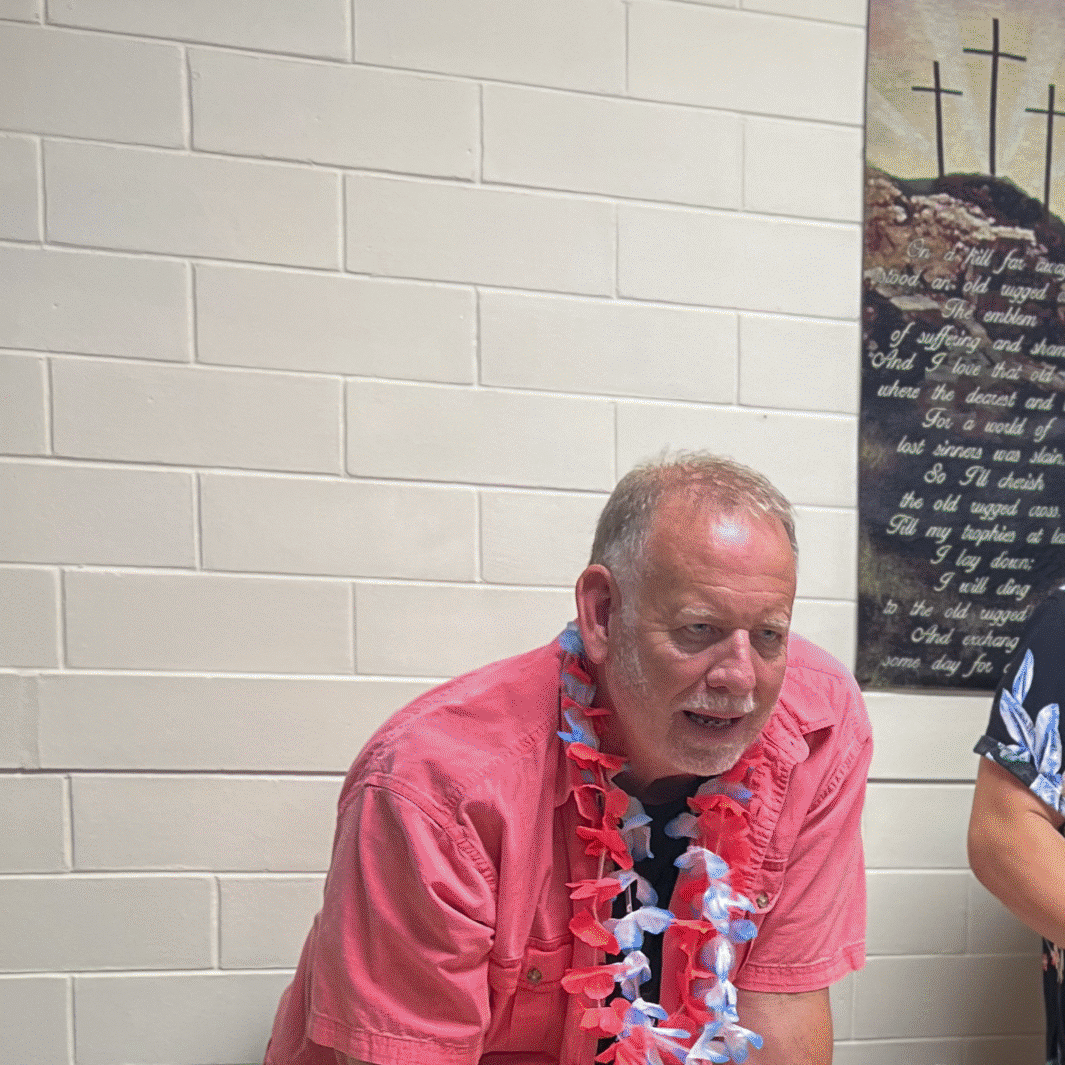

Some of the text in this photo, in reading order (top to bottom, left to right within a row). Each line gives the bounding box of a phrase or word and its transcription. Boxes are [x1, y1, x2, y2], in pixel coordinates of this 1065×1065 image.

[965, 248, 993, 267] hill
[993, 250, 1026, 274] far
[963, 277, 991, 294] old
[1000, 283, 1049, 304] rugged
[941, 298, 1038, 327] The emblem
[889, 322, 915, 348] of
[917, 325, 981, 353] suffering
[993, 336, 1024, 353] and
[871, 349, 917, 371] And
[925, 352, 947, 372] I
[952, 358, 980, 376] love
[992, 361, 1022, 380] that
[1030, 366, 1055, 383] old
[877, 380, 920, 399] where
[931, 384, 955, 401] the
[965, 387, 1018, 407] dearest
[1025, 394, 1055, 410] and
[922, 407, 1057, 442] For a world of
[897, 435, 925, 454] lost
[933, 440, 982, 459] sinners
[993, 449, 1021, 462] was
[924, 463, 947, 483] So
[998, 472, 1045, 491] cherish
[900, 491, 924, 509] the
[933, 494, 961, 512] old
[971, 499, 1021, 520] rugged
[886, 514, 919, 536] Till
[925, 525, 952, 543] my
[961, 524, 1016, 547] trophies
[1027, 529, 1043, 543] at
[931, 545, 952, 564] I
[956, 549, 981, 573] lay
[934, 572, 1031, 601] I will cling
[883, 600, 1028, 626] to the old rugged
[911, 625, 1019, 653] And exchang
[881, 655, 921, 668] some
[931, 653, 961, 676] day
[962, 653, 992, 677] for
